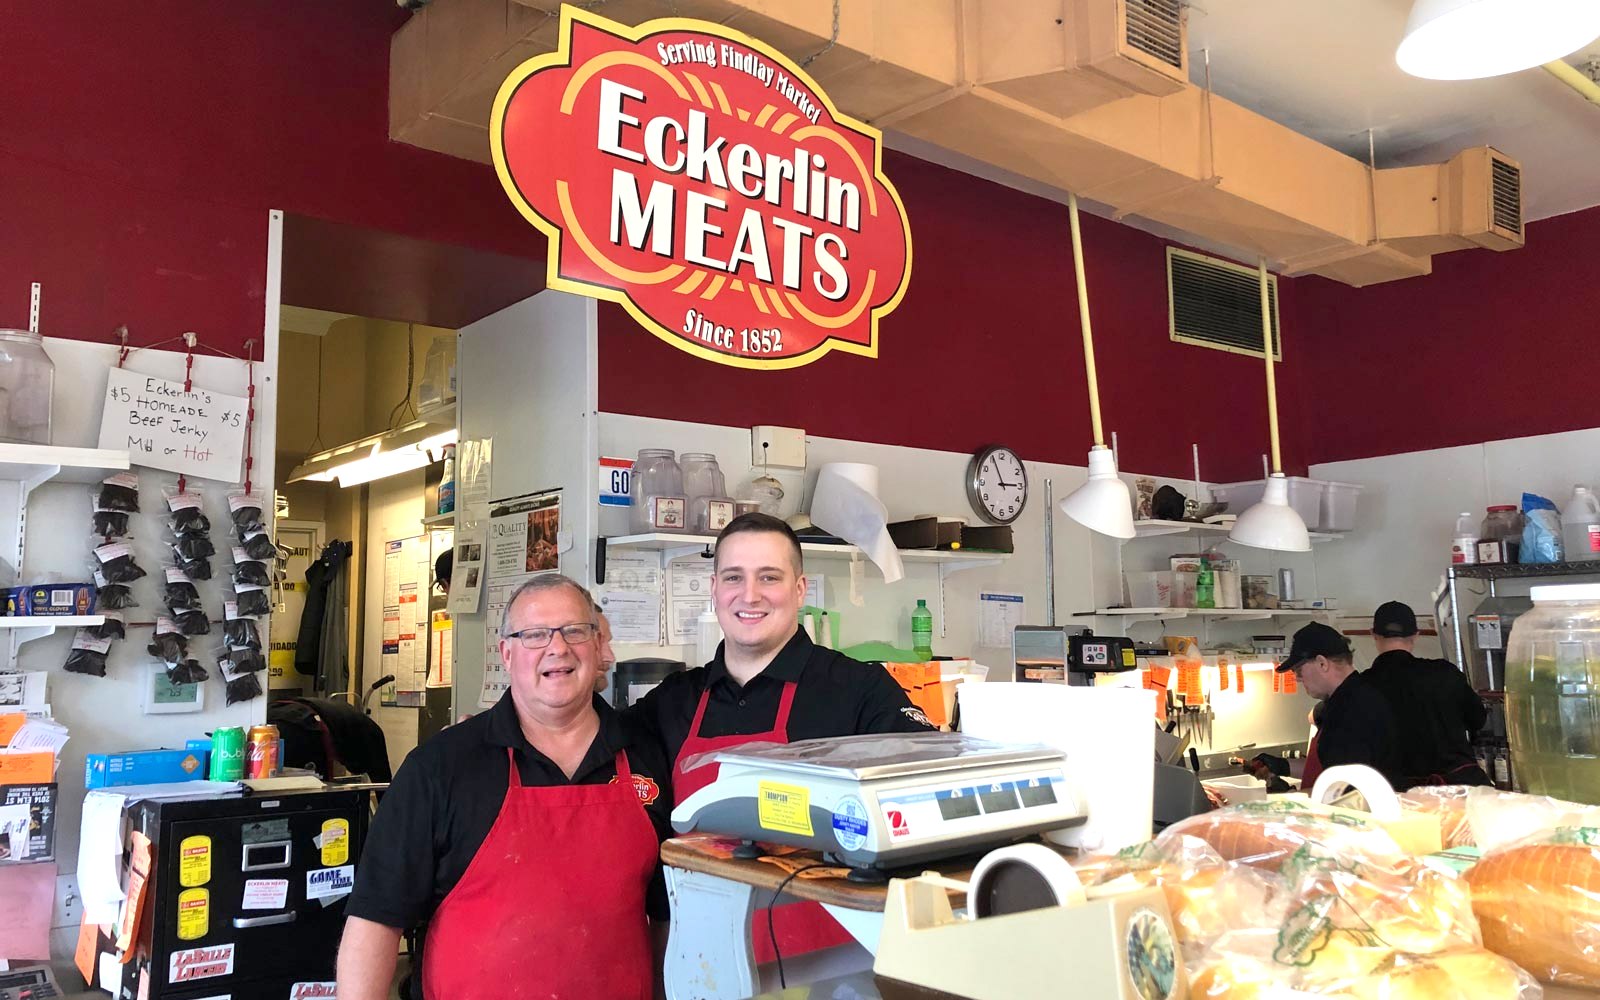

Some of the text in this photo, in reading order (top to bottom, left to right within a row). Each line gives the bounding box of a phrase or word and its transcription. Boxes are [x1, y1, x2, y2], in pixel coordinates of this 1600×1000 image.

[656, 40, 821, 124] Serving Findlay Market
[597, 78, 861, 231] Eckerlin
[609, 168, 849, 300] MEATS
[683, 308, 783, 352] Since 1852
[110, 386, 131, 403] $5
[221, 410, 241, 428] $5
[170, 419, 208, 443] Jerky
[164, 446, 177, 455] or
[183, 444, 213, 461] Hot
[1015, 468, 1020, 476] 2
[611, 470, 629, 494] GO
[1017, 482, 1023, 490] 3
[983, 493, 989, 501] 8
[990, 504, 995, 512] 7
[497, 522, 527, 537] QUALITY
[5, 795, 50, 805] 2014 ELM ST
[765, 791, 788, 803] THOMPSON
[309, 869, 341, 885] GAME
[332, 876, 351, 885] TIME
